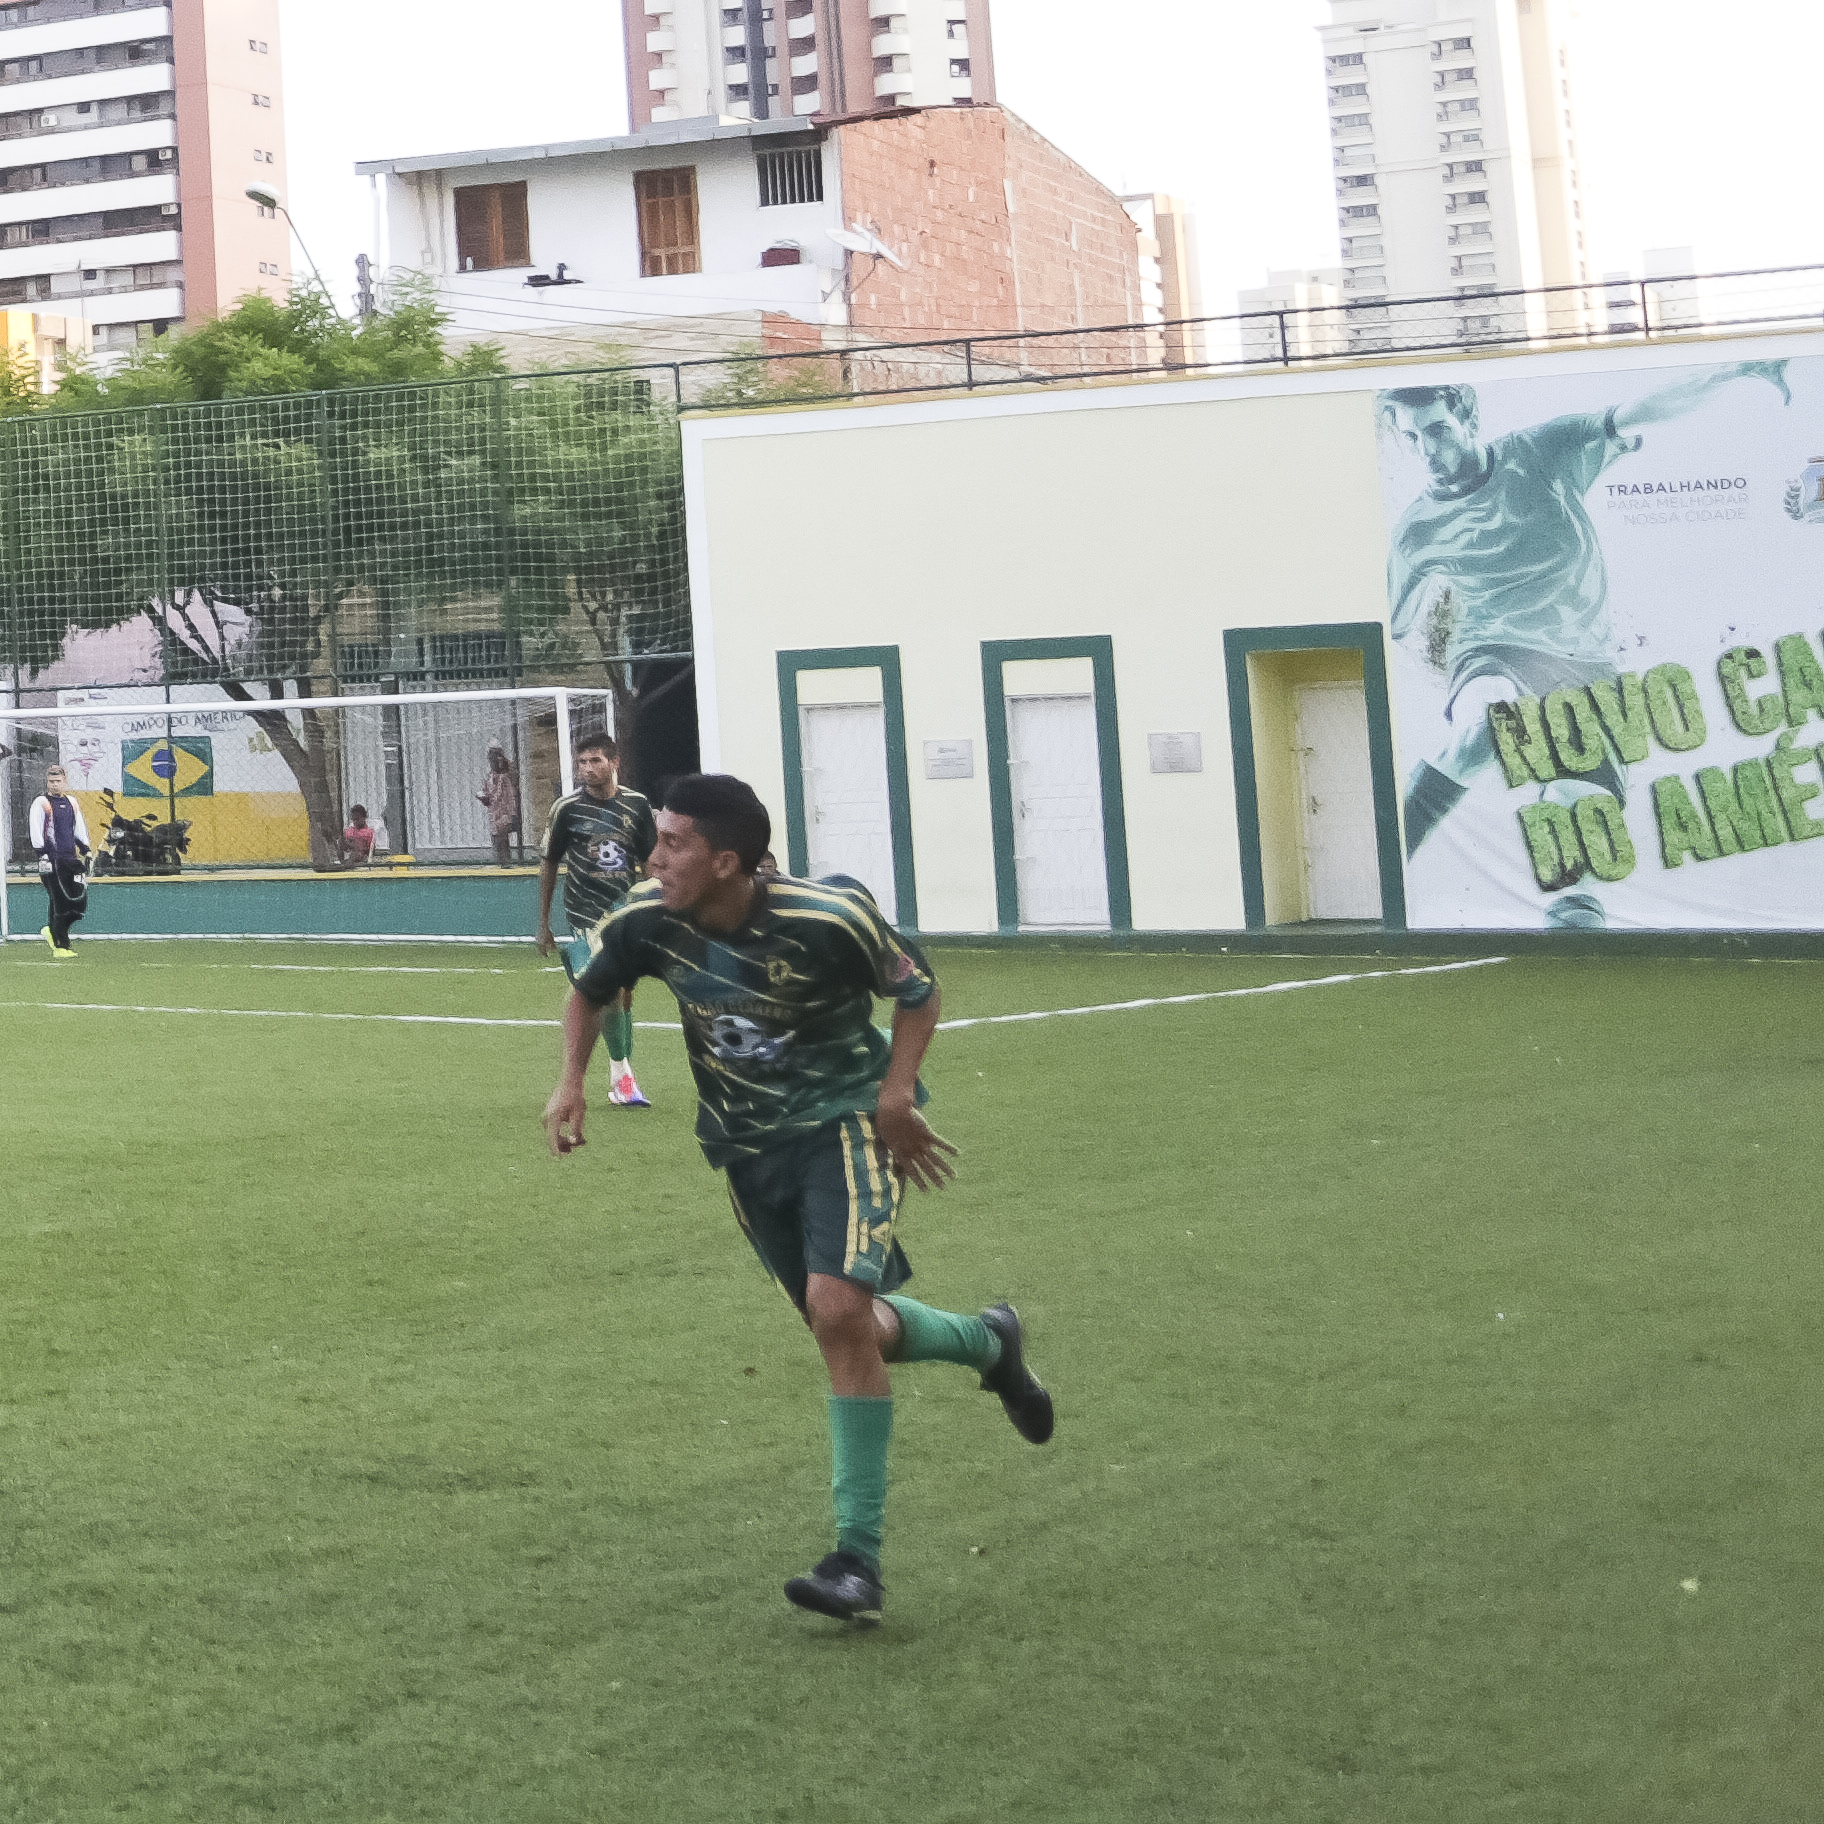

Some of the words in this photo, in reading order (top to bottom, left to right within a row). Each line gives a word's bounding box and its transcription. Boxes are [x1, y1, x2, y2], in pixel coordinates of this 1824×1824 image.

[1605, 477, 1747, 497] TRABALHANDO
[1607, 498, 1651, 511] PARA
[1656, 492, 1749, 509] MELHORAR
[1623, 512, 1681, 526] NOSSA
[1684, 507, 1746, 523] CIDADE
[1487, 662, 1707, 790] NOVO
[1716, 628, 1824, 737] CA
[121, 717, 165, 734] CAMPO
[1516, 794, 1637, 893] DO
[1651, 727, 1824, 869] AMÉ
